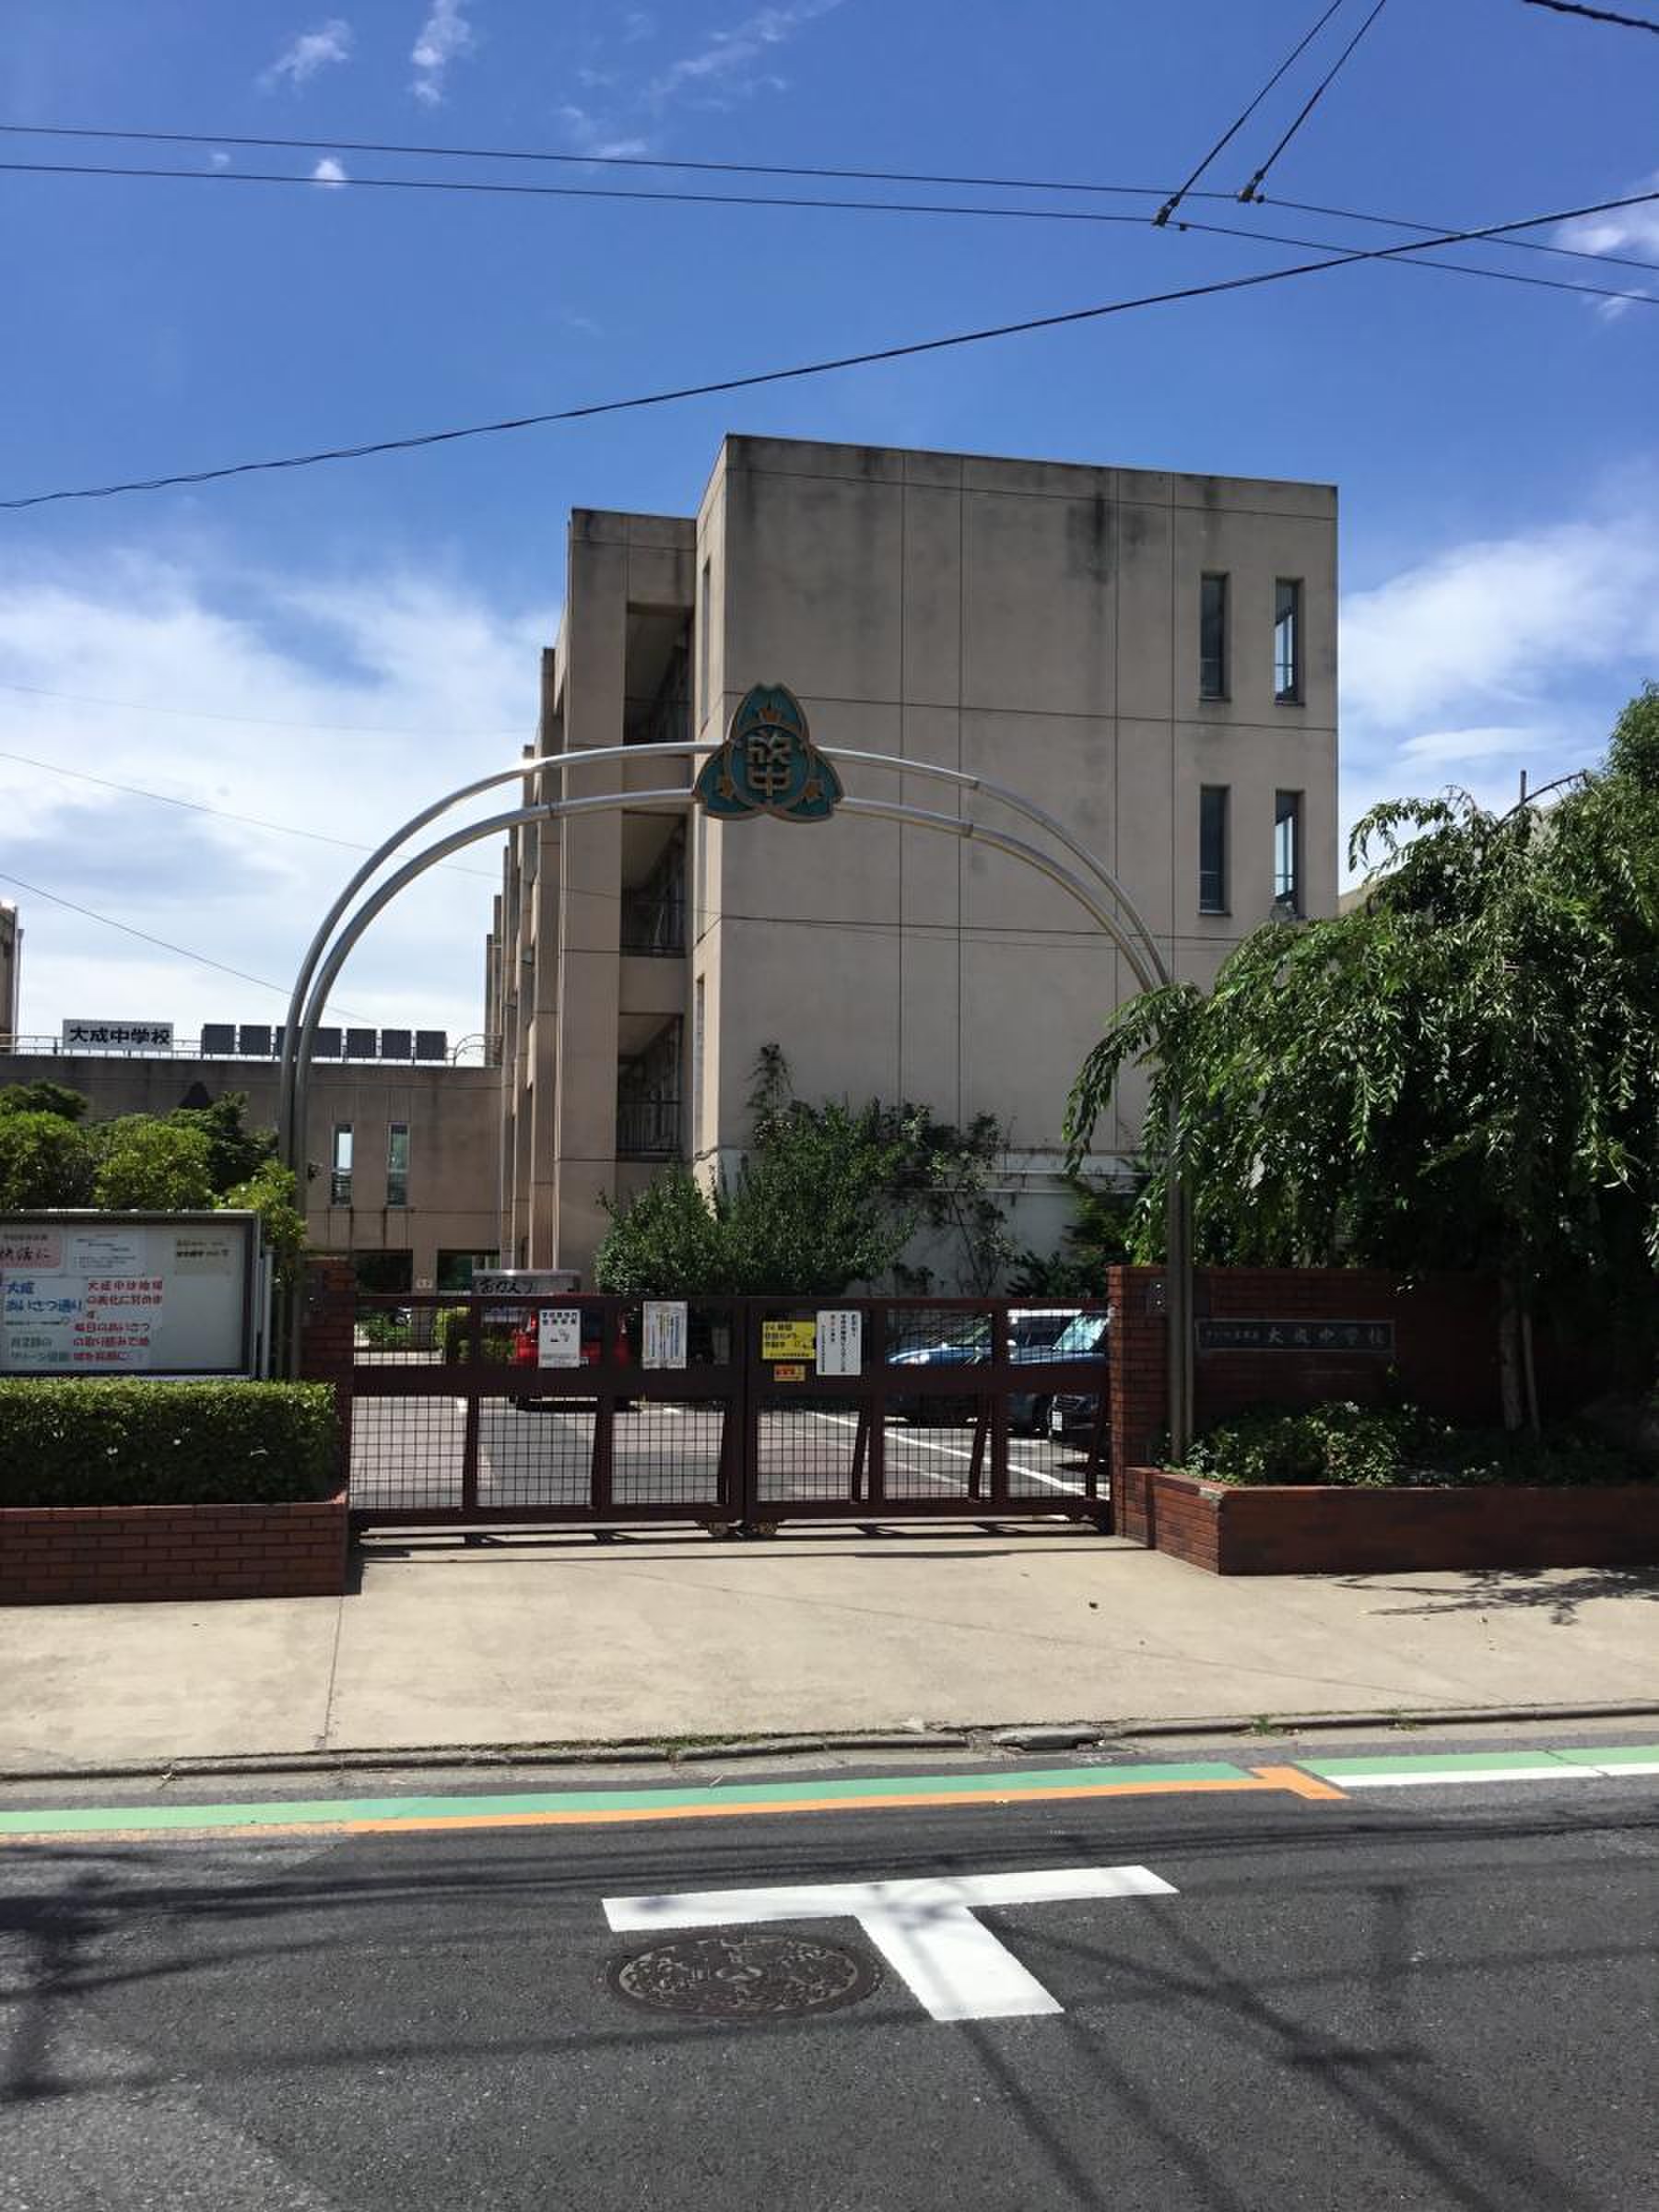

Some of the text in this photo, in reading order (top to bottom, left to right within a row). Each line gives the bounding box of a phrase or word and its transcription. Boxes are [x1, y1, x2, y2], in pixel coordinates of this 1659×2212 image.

[69, 1026, 171, 1044] 大成中学校
